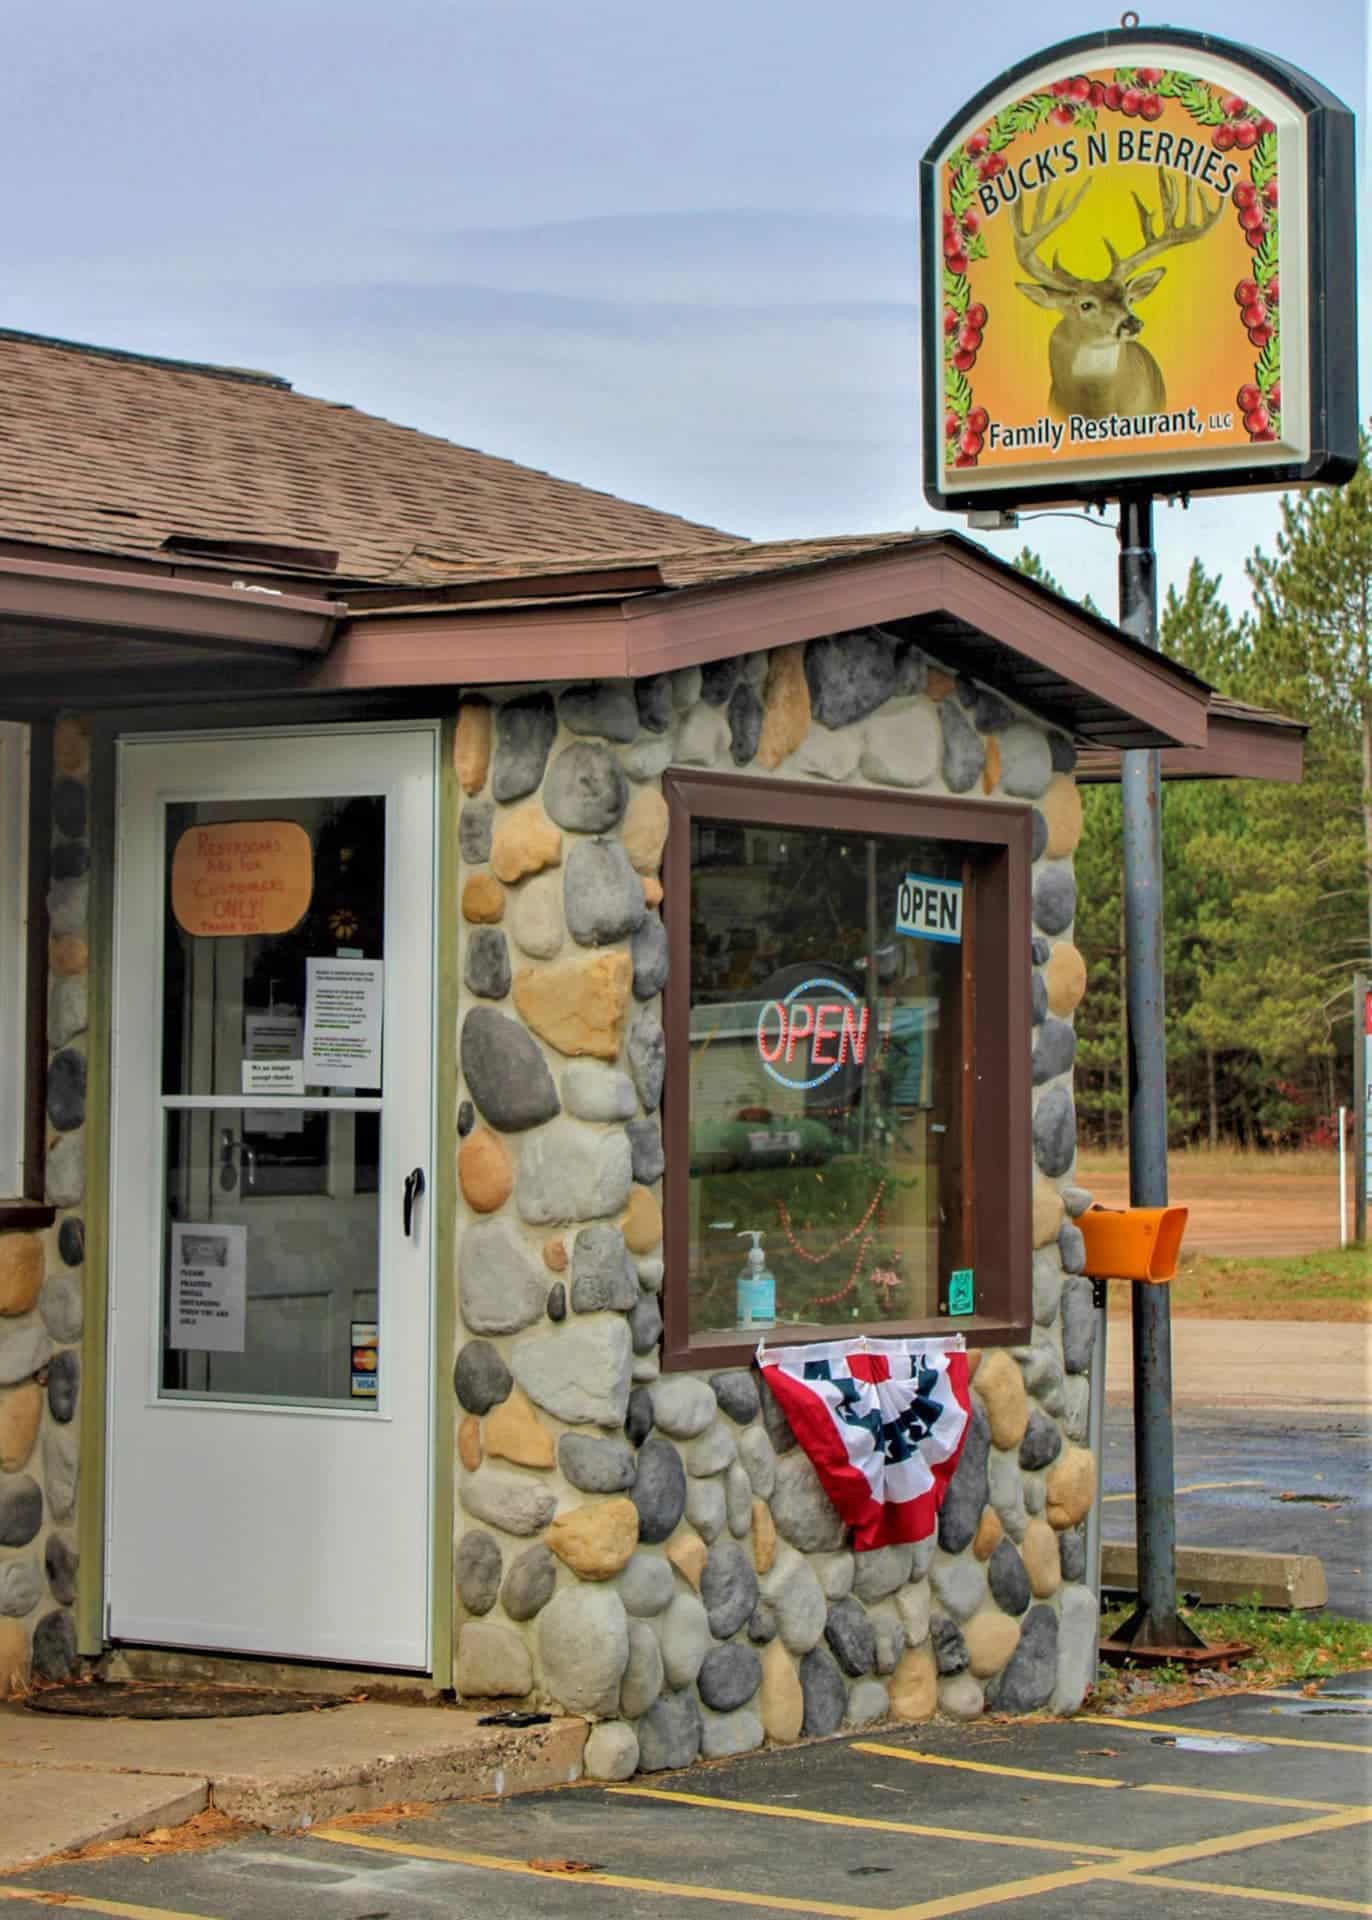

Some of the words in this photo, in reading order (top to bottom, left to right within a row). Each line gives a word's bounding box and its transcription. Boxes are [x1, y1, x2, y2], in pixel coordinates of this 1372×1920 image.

[978, 140, 1078, 216] BUCK'S
[1087, 132, 1107, 166] N
[1117, 129, 1238, 194] BERRIES
[989, 416, 1063, 449] Family
[1069, 407, 1203, 441] Restaurant,
[1208, 413, 1232, 429] LLC
[900, 883, 958, 931] OPEN
[758, 1000, 869, 1065] OPEN
